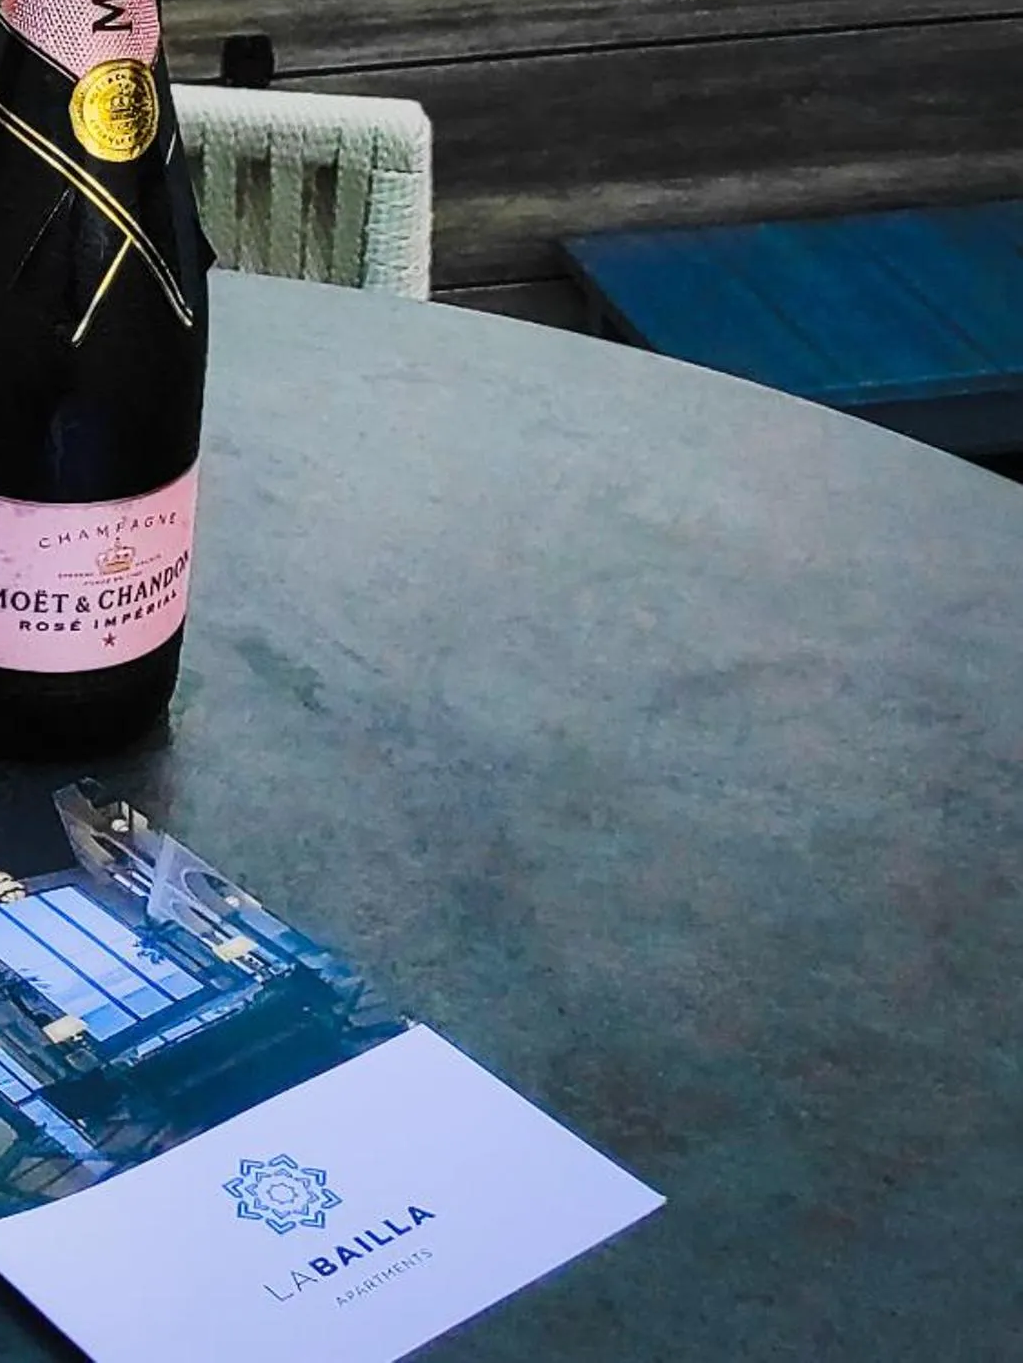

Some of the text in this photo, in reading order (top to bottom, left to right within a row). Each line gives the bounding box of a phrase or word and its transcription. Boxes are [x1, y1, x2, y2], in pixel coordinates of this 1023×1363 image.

[38, 511, 178, 549] CHAMPAGNE
[75, 596, 91, 613] &
[18, 619, 83, 632] ROSÉ
[336, 1247, 434, 1308] APARTMENTS
